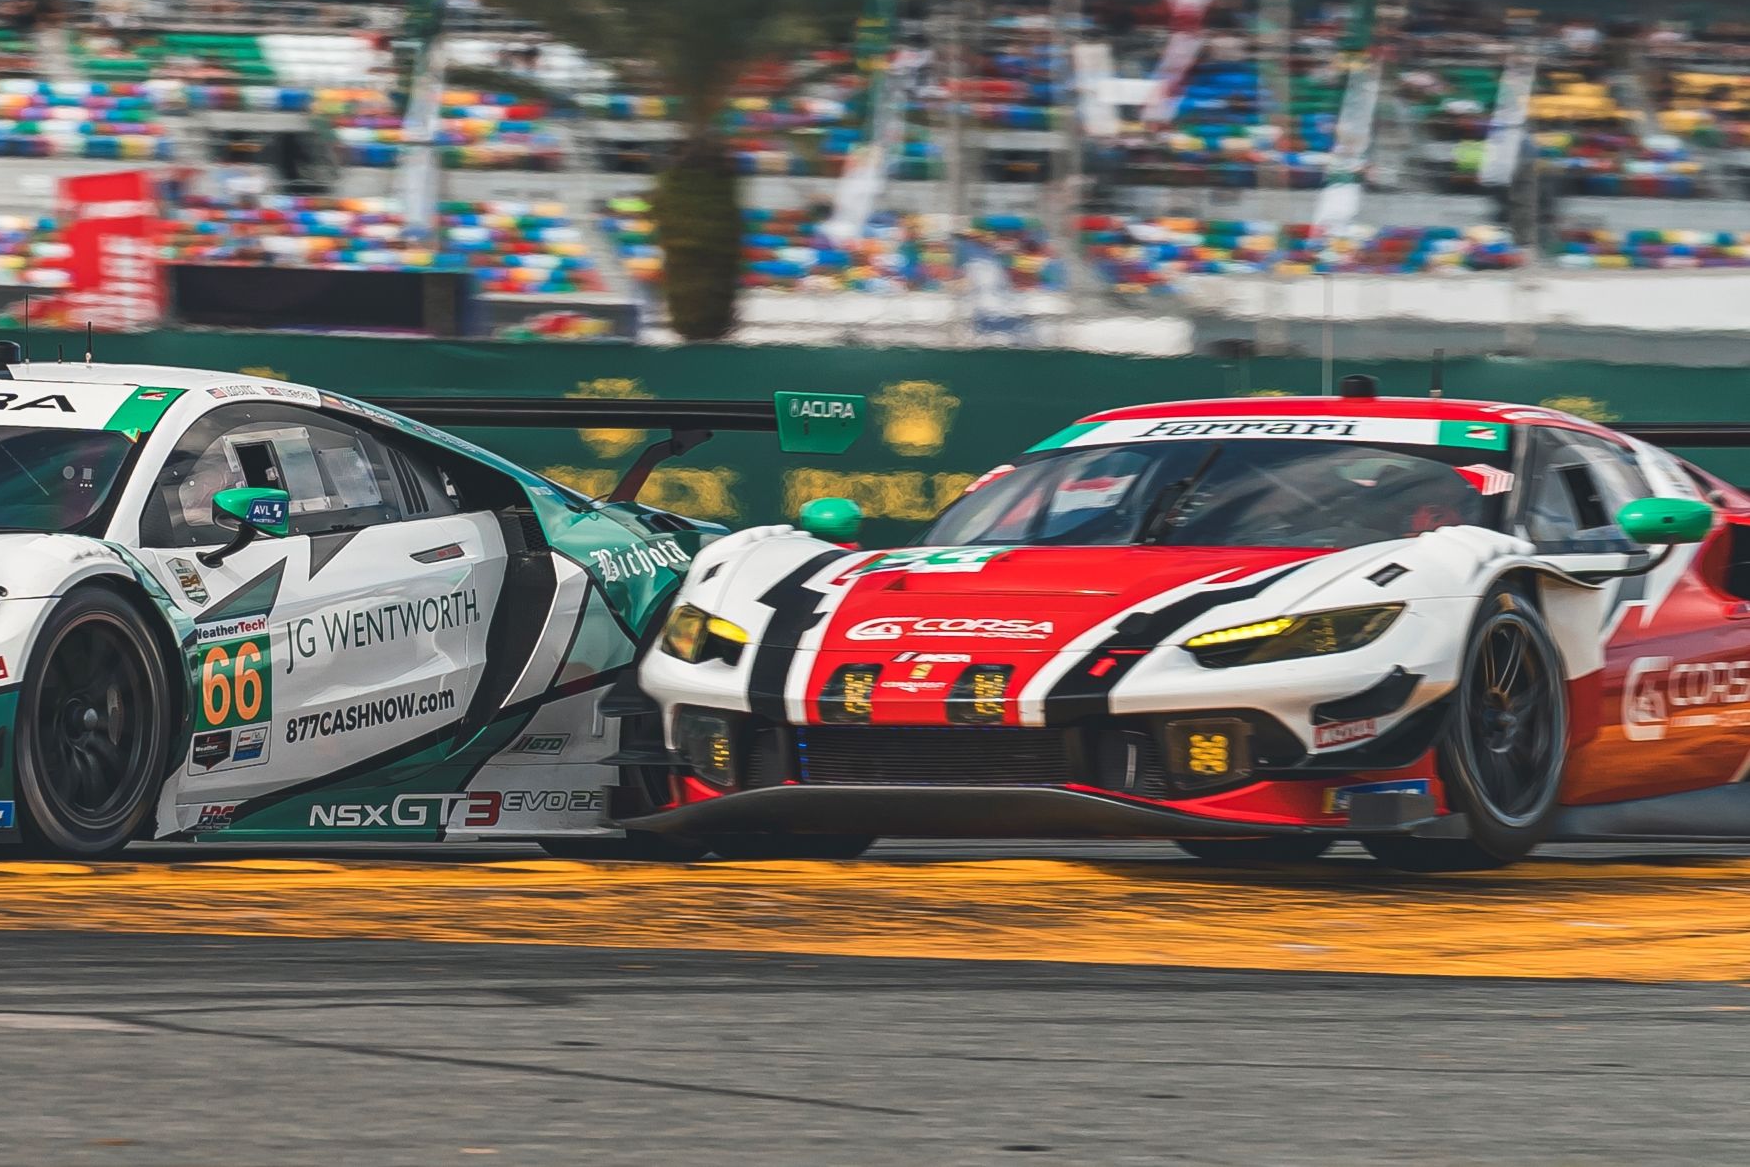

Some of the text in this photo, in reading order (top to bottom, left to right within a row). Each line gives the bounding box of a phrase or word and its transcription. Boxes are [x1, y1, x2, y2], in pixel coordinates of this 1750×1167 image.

[800, 400, 856, 419] ACURA
[1133, 419, 1362, 438] Ferrari
[253, 504, 271, 516] AVL
[589, 539, 692, 589] Bichota
[912, 618, 1054, 633] CORSA
[285, 617, 317, 675] JG
[202, 641, 263, 726] 66
[1668, 661, 1750, 706] CORS
[285, 688, 456, 744] 877CASHNOW.com
[529, 737, 564, 751] GTD
[197, 805, 235, 824] HRC
[308, 805, 389, 828] NSX
[390, 790, 504, 828] GT3
